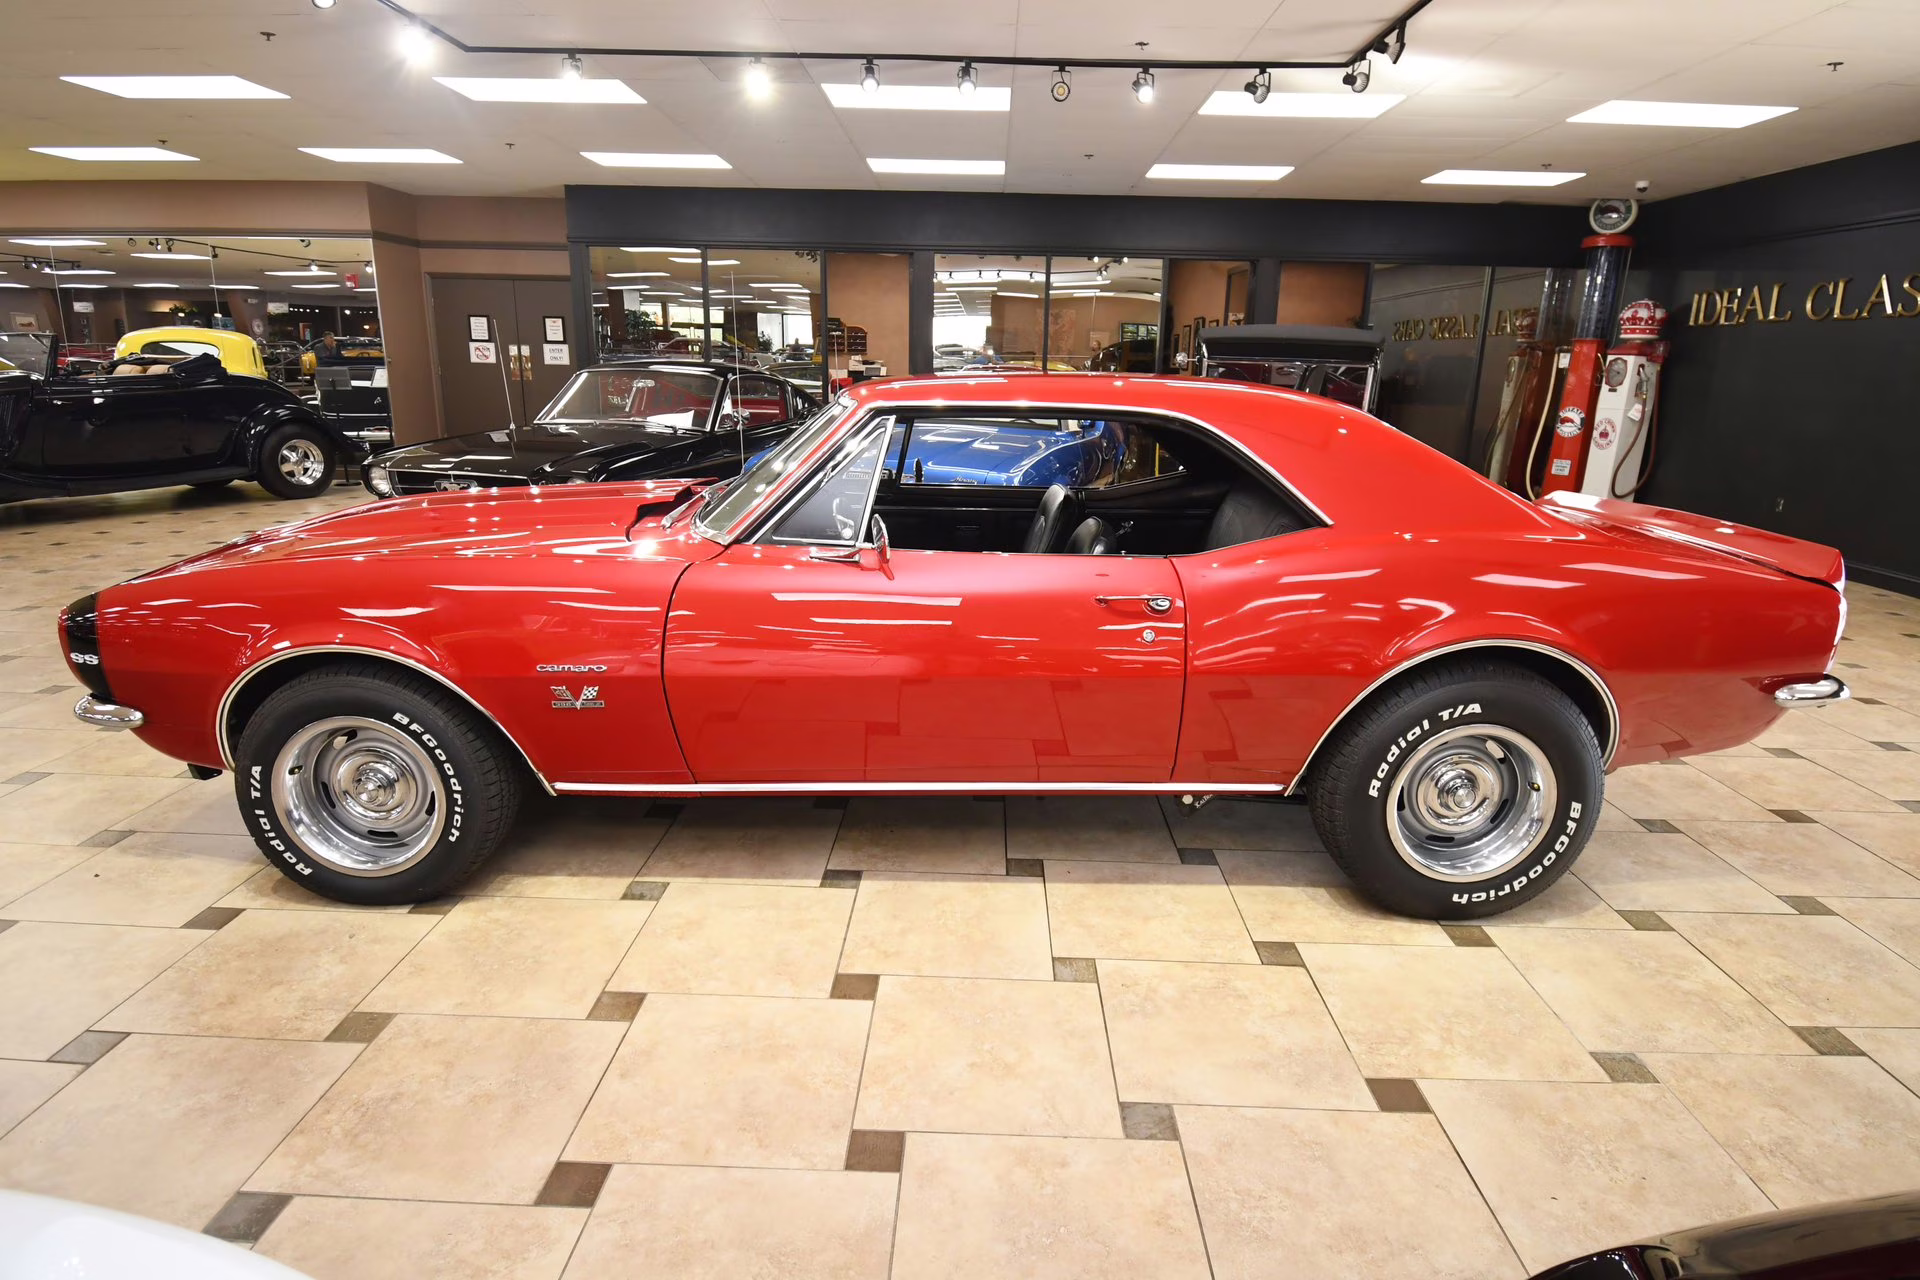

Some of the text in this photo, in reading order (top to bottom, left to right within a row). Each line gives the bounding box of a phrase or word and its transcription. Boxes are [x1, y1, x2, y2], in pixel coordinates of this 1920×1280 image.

[1688, 273, 1920, 327] IDEAL CLAS
[70, 652, 99, 665] SS
[536, 664, 608, 672] camaro
[392, 712, 464, 843] BFGoodrich
[1368, 703, 1483, 798] Radial T/A
[250, 765, 313, 876] Radial T/A
[1452, 800, 1583, 905] BFGoodrich
